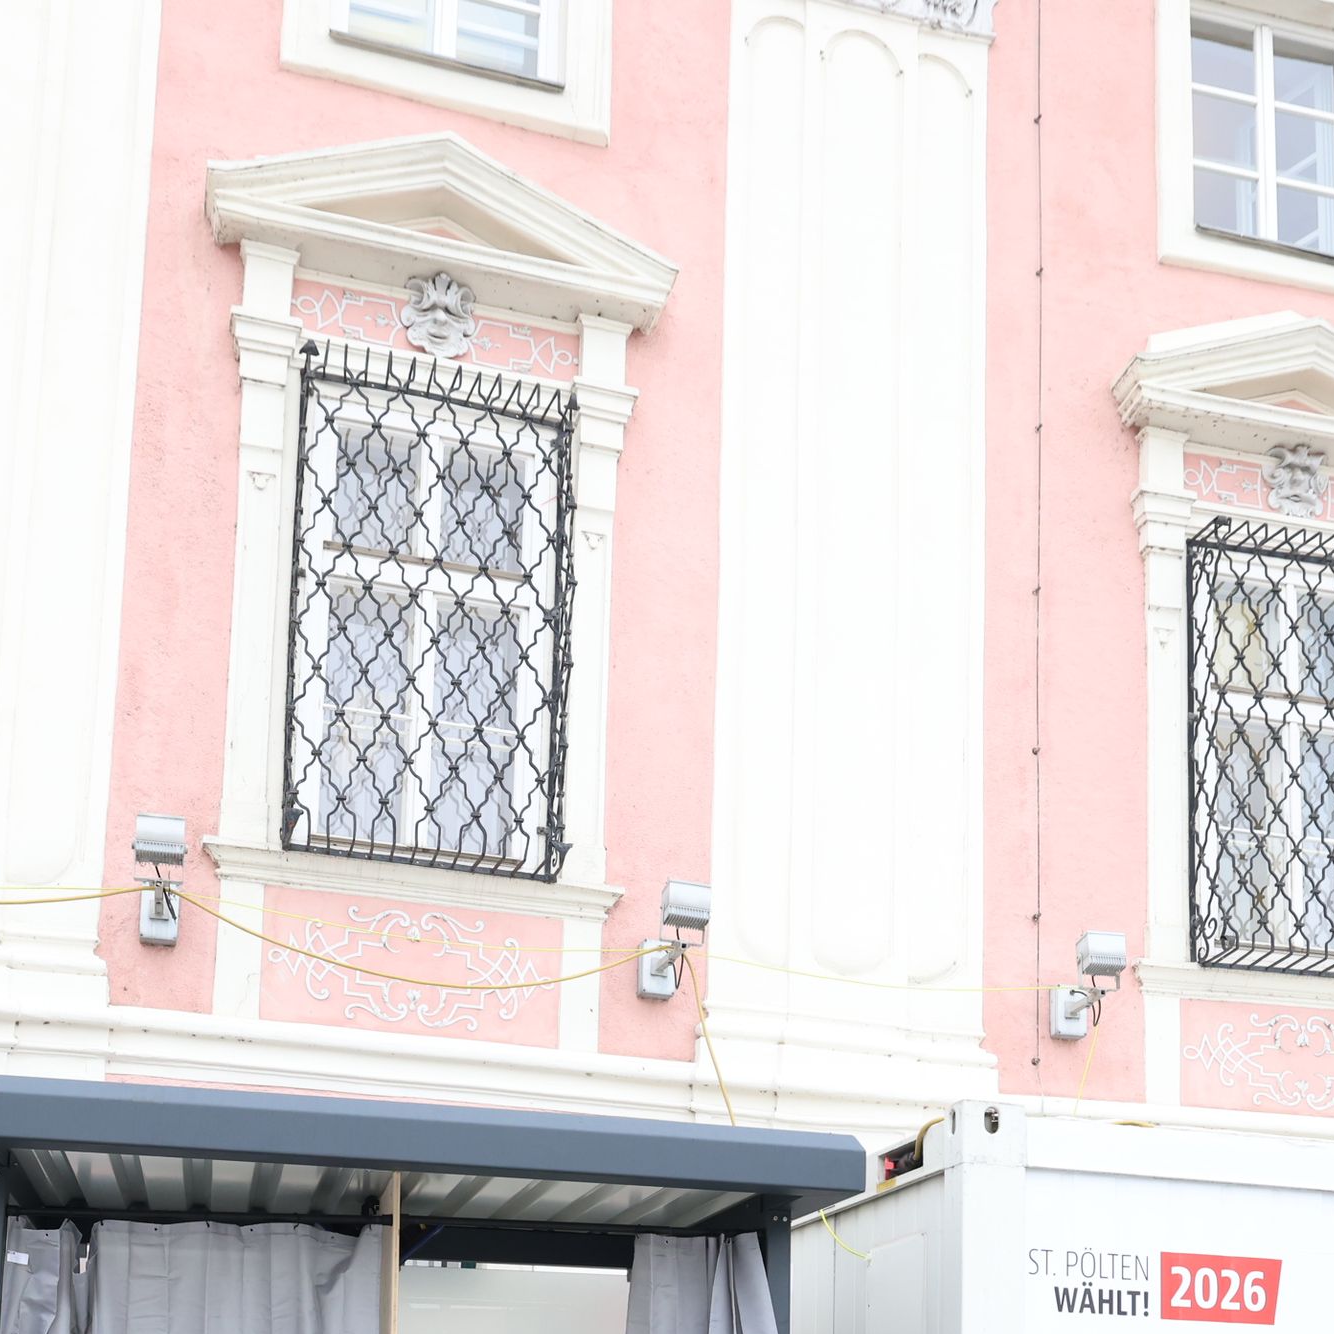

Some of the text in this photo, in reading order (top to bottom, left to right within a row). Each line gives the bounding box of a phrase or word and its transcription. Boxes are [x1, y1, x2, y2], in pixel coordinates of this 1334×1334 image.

[1028, 1246, 1150, 1282] ST. PÖLTEN
[1053, 1281, 1150, 1318] WÄHLT!
[1169, 1265, 1267, 1313] 2026
